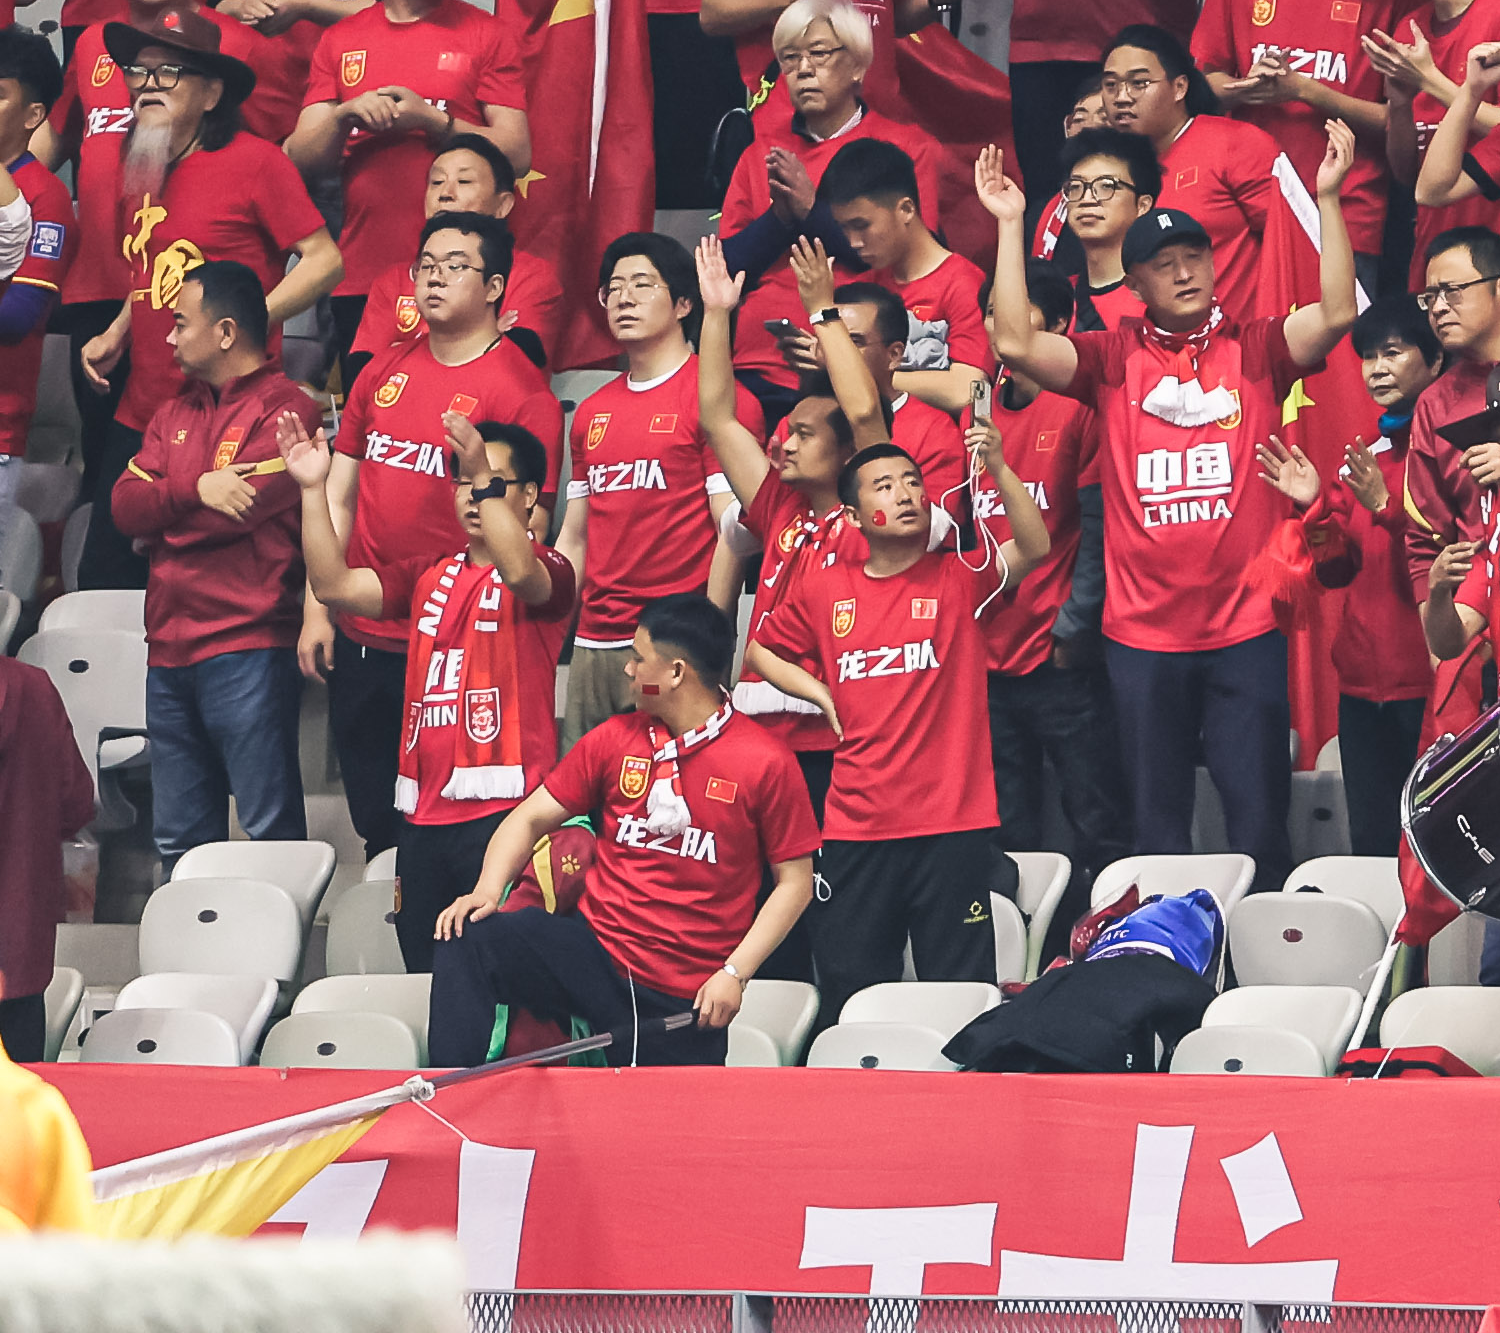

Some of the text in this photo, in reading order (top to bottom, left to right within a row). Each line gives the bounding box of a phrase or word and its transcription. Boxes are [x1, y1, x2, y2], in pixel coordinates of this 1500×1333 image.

[366, 431, 448, 477] 龙之队
[1135, 441, 1234, 489] 中国
[588, 458, 669, 495] 龙之队
[1143, 497, 1234, 529] CHINA
[837, 640, 939, 682] 龙之队
[615, 814, 718, 864] 龙之队
